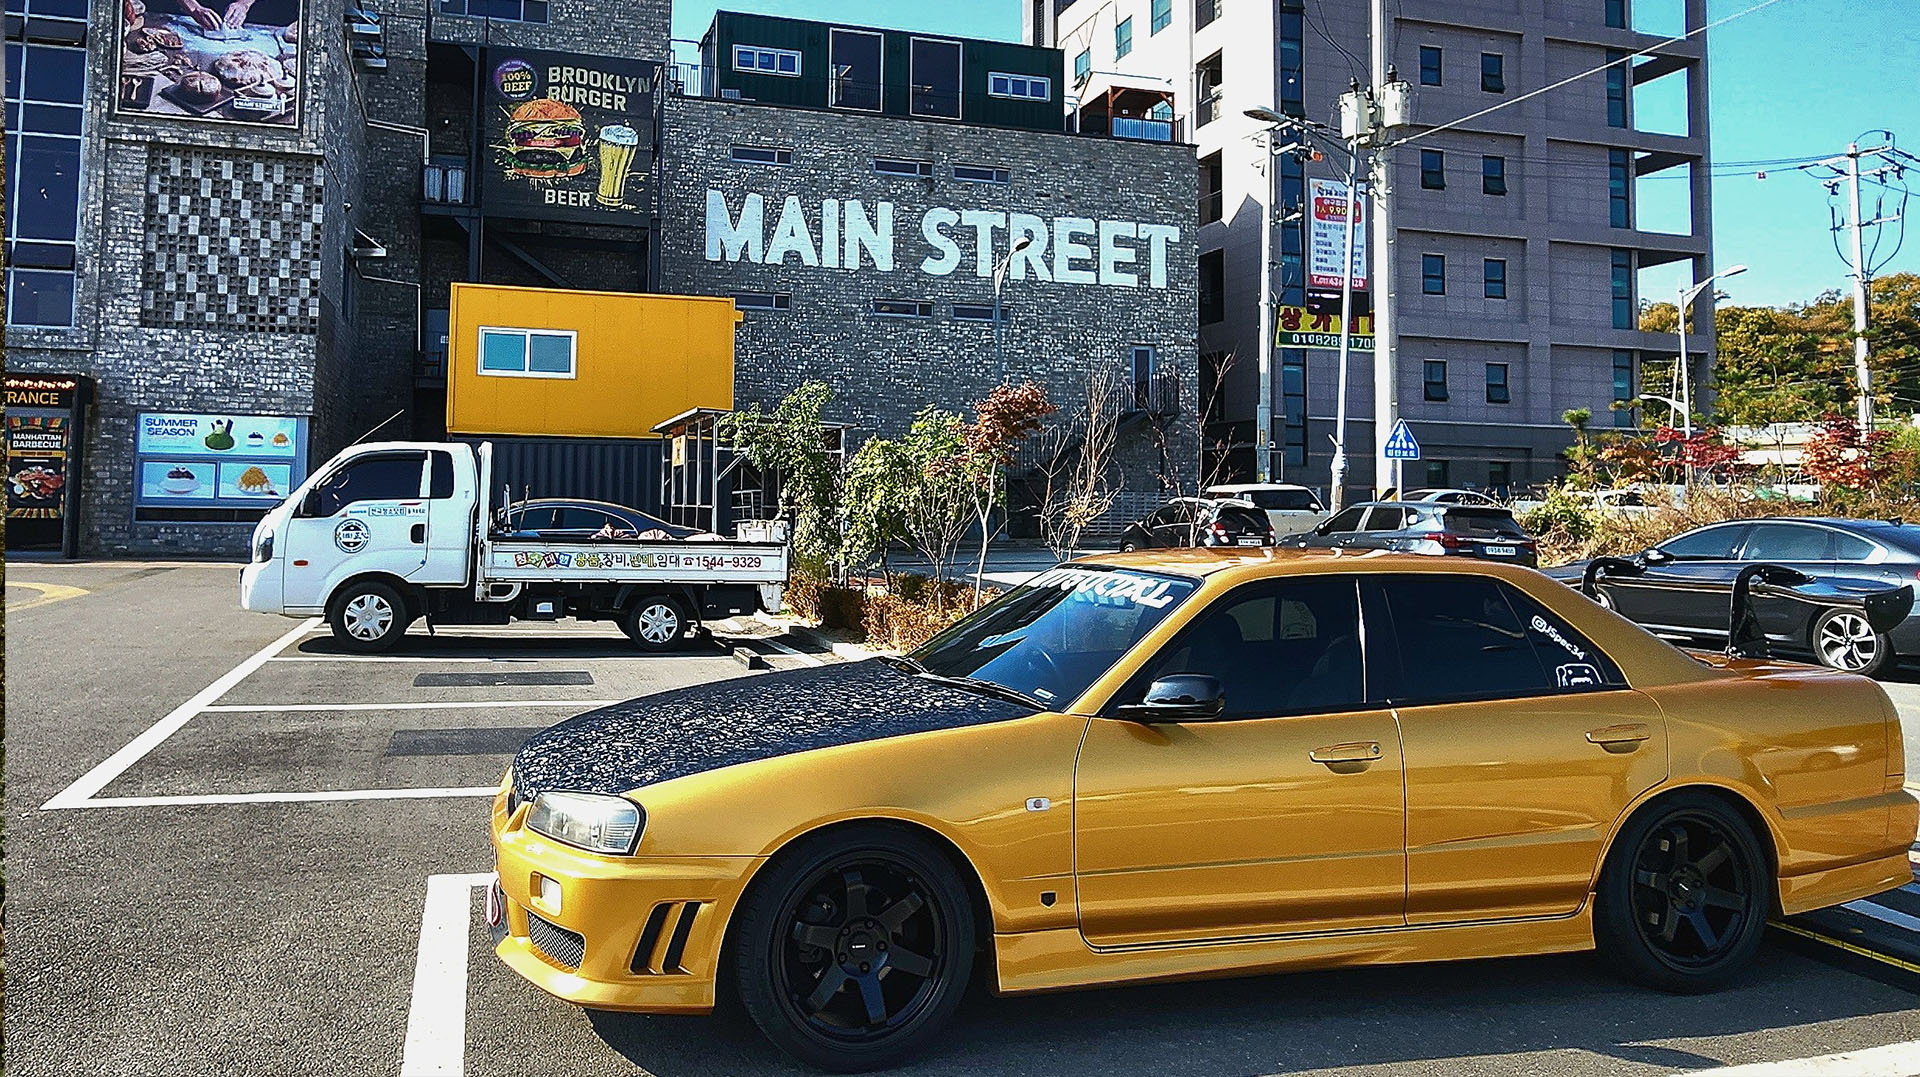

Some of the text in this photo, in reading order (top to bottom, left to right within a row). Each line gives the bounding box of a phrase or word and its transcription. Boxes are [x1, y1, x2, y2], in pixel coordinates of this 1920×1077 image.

[501, 71, 531, 81] 100%
[548, 66, 650, 93] BROOKLYN
[503, 81, 533, 92] BEEF
[548, 86, 626, 111] BURGER
[544, 189, 591, 207] BEER
[706, 189, 1180, 289] MAIN STREET
[5, 391, 60, 405] RANCE
[145, 417, 198, 428] SUMMER
[12, 433, 62, 441] MANHATTAN
[147, 427, 195, 436] SEASON
[12, 440, 62, 448] BARBECUE
[695, 556, 762, 568] 1544-9329
